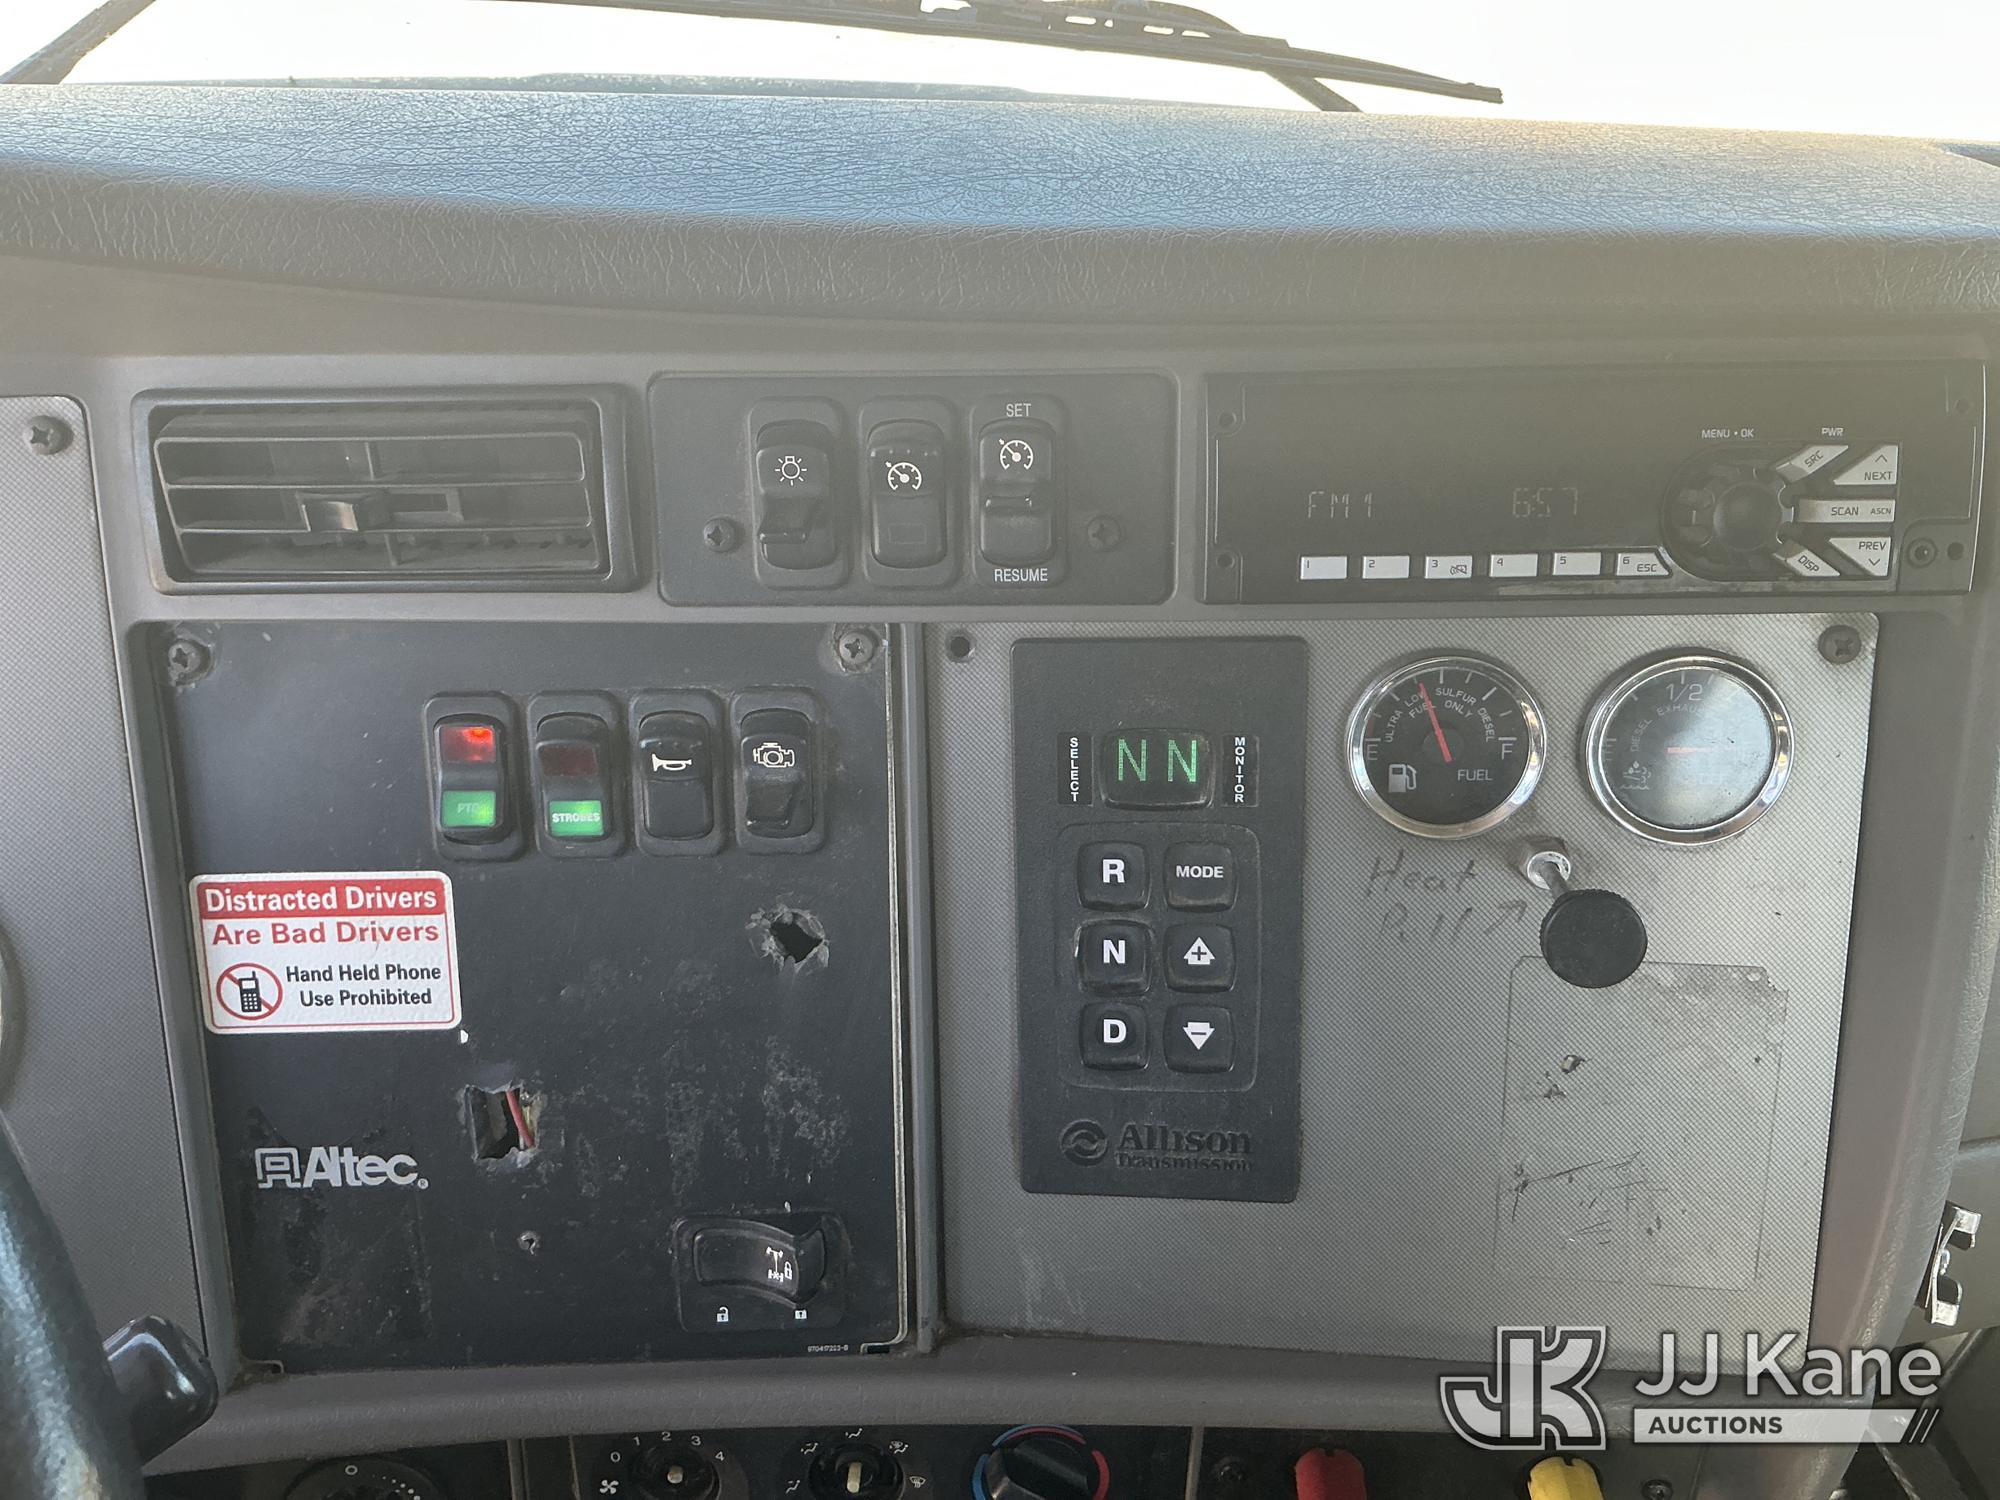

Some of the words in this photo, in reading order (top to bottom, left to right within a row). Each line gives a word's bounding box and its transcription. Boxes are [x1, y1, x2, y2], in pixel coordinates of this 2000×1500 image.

[1006, 403, 1032, 418] SET
[1701, 428, 1731, 439] MENU
[1740, 428, 1755, 439] OK
[1821, 427, 1844, 437] PWR
[1804, 450, 1824, 468] SRC
[1864, 471, 1893, 481] NEXT
[1831, 506, 1860, 517] SCAN
[1870, 508, 1892, 516] ASCN
[1858, 540, 1887, 551] PREV
[1368, 559, 1376, 569] 2
[1431, 559, 1439, 568] 3
[1496, 557, 1504, 567] 4
[1559, 556, 1567, 566] 5
[1622, 556, 1630, 565] 6
[1636, 563, 1658, 573] ESC
[1798, 554, 1820, 573] DISP
[994, 568, 1049, 583] RESUME
[1435, 687, 1477, 706] SULFUR
[1665, 683, 1704, 702] 1/2
[1444, 700, 1474, 718] ONLY
[1384, 708, 1403, 744] ULTRA
[1476, 707, 1496, 743] DIESEL
[1630, 717, 1653, 752] DIESEL
[1366, 743, 1379, 761] E
[1501, 743, 1514, 760] F
[1118, 738, 1147, 782] N
[1167, 739, 1197, 783] N
[1069, 737, 1080, 802] SELECT
[1234, 736, 1246, 803] MONITOR
[1457, 769, 1493, 782] FUEL
[552, 812, 601, 823] STROBES
[1102, 858, 1126, 884] R
[1175, 865, 1224, 878] MODE
[205, 886, 337, 913] Distracted
[345, 884, 437, 910] Drivers
[212, 923, 262, 946] Are
[271, 921, 326, 944] Bad
[336, 920, 440, 943] Drivers
[1102, 939, 1126, 964] N
[286, 964, 333, 983] Hand
[339, 963, 380, 981] Held
[385, 963, 442, 981] Phone
[300, 989, 335, 1007] Use
[340, 988, 432, 1006] Prohibited
[1103, 1018, 1128, 1044] D
[1119, 1122, 1251, 1154] Allison
[1114, 1151, 1251, 1172] Transmission
[633, 1436, 641, 1446] 1
[661, 1431, 672, 1442] 2
[690, 1435, 702, 1446] 3
[714, 1450, 726, 1462] 4
